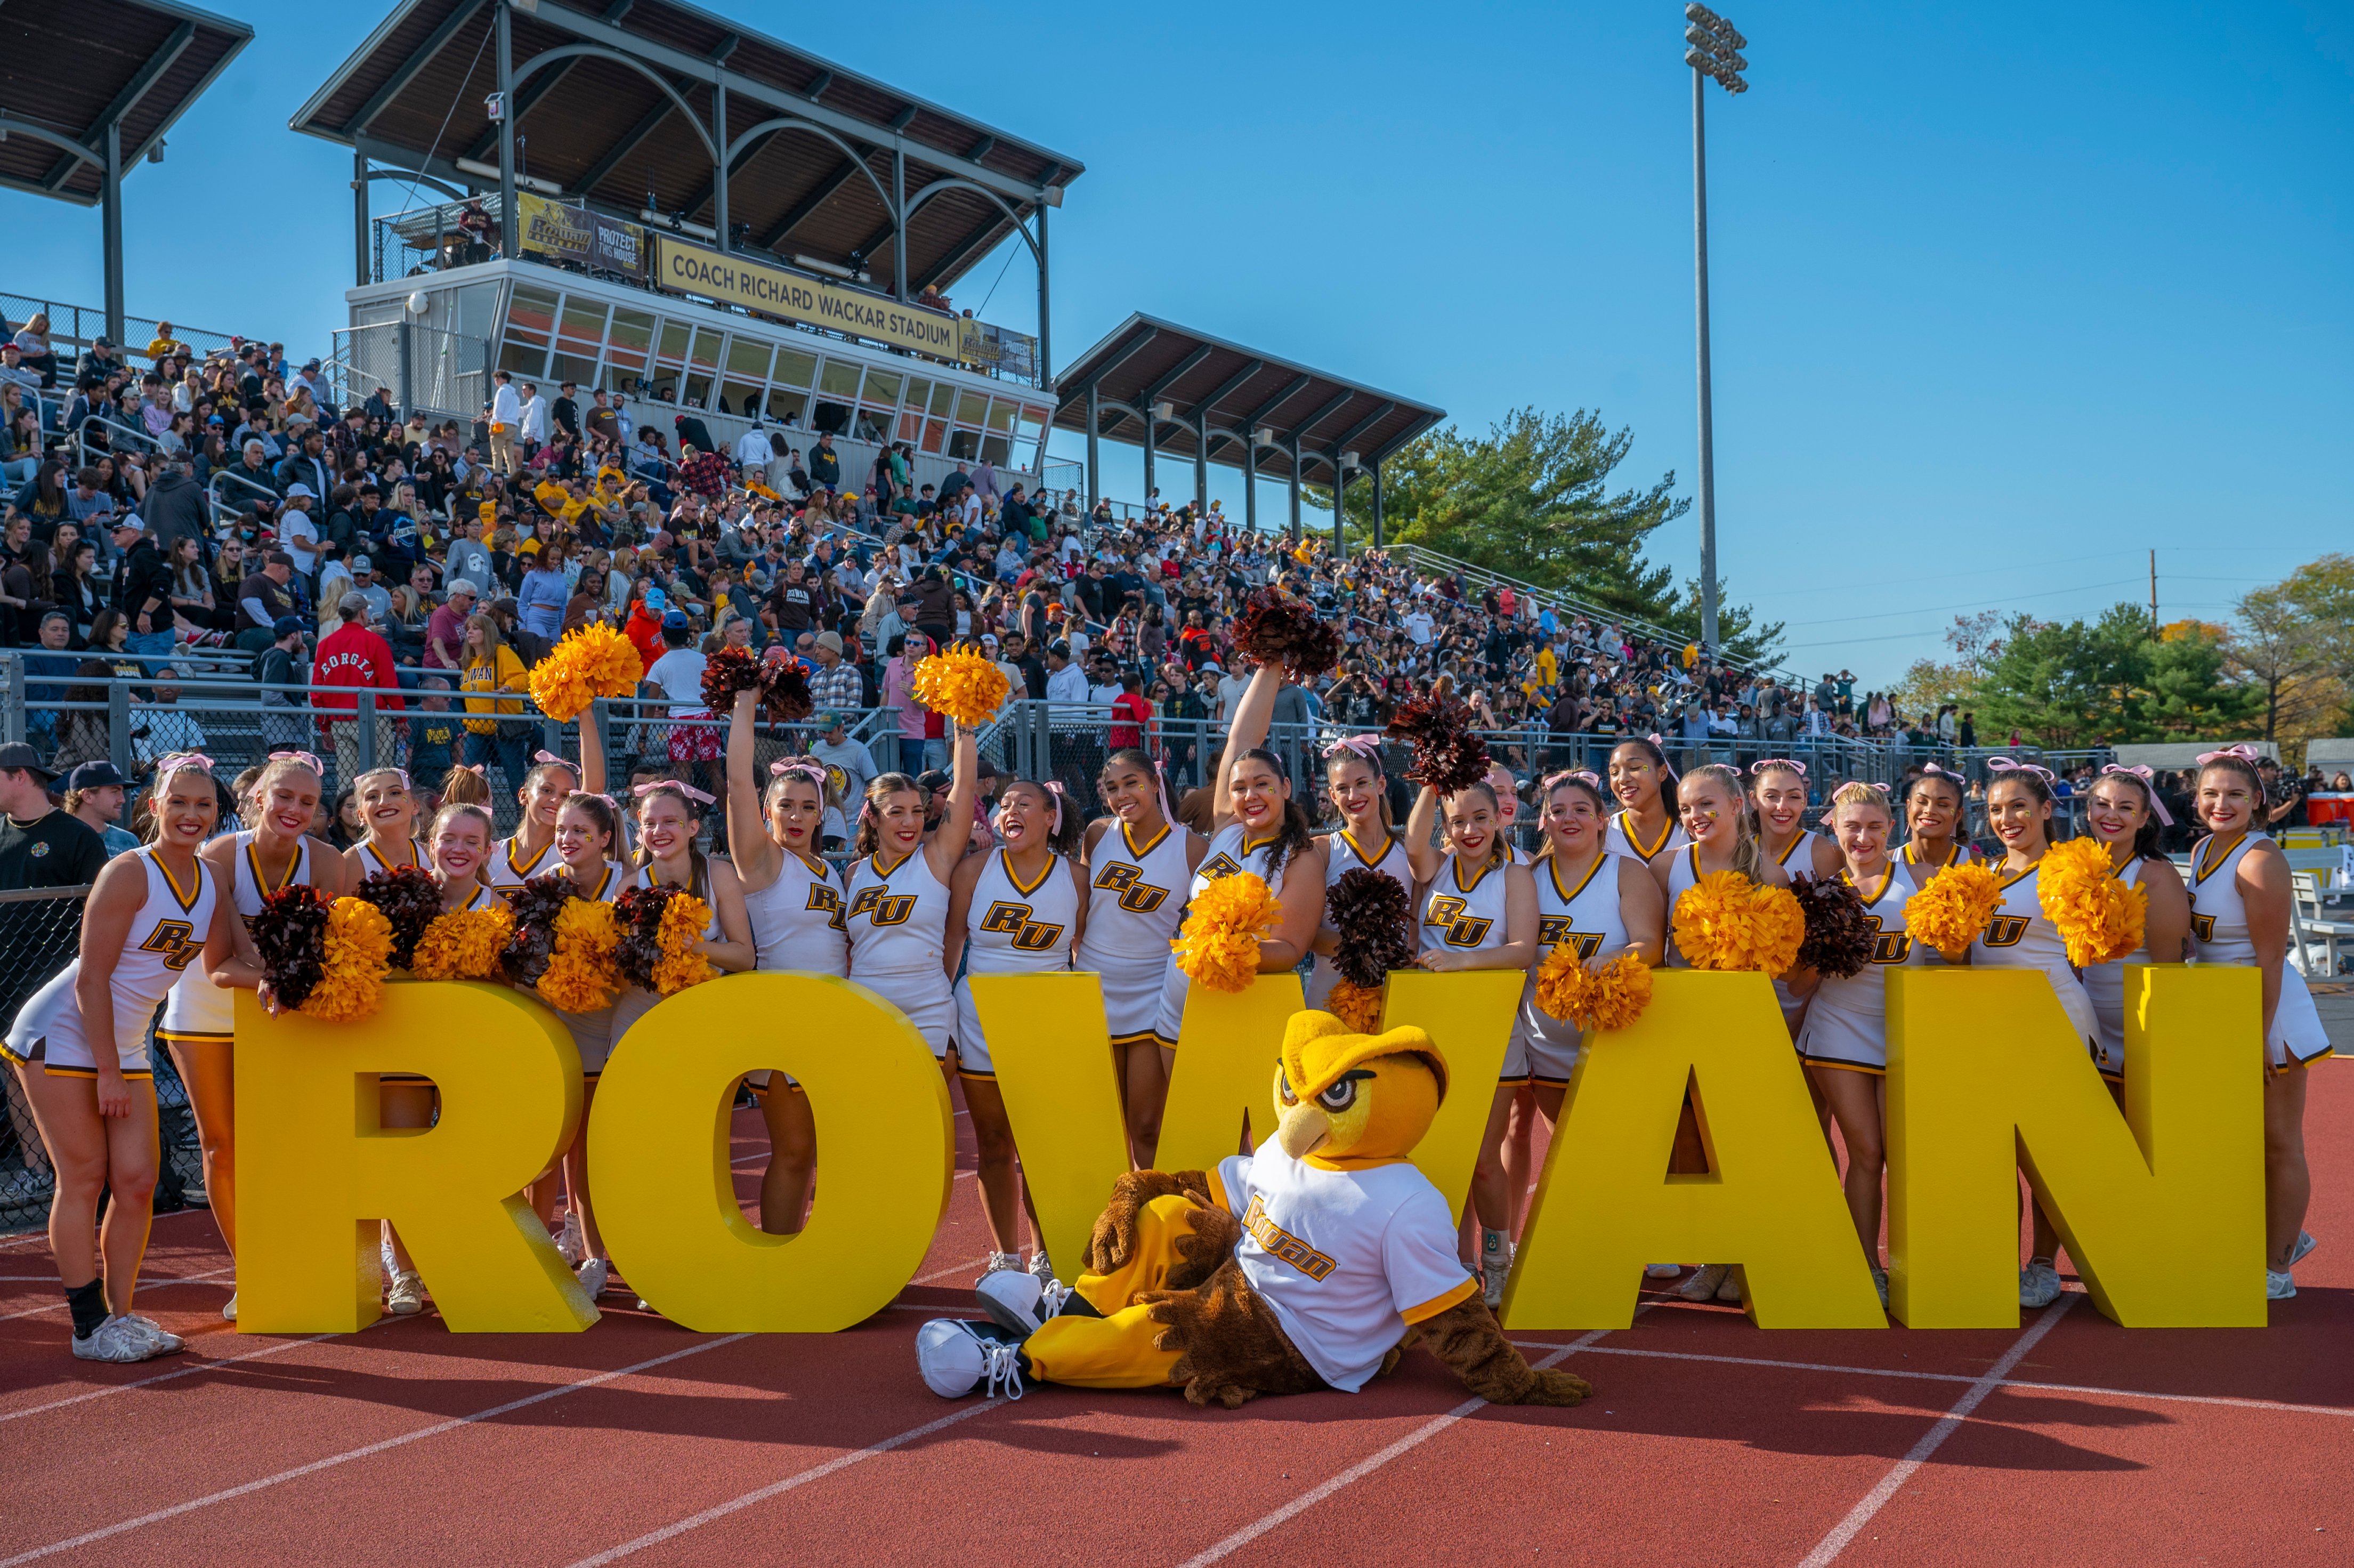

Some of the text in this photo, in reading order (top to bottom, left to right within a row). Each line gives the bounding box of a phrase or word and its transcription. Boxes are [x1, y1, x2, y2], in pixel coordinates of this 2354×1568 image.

[528, 231, 586, 252] FOOTBALL
[598, 226, 635, 252] PROTECT
[598, 241, 638, 265] THIS HOUSE.
[673, 254, 950, 347] COACH RICHARD WACKAR STADIUM
[1006, 340, 1031, 357] PROTECT
[787, 588, 809, 601] ROWAN
[321, 653, 374, 683] EORGIA
[1094, 860, 1170, 913] RU
[1196, 851, 1242, 882] R
[848, 884, 919, 926] RU
[980, 900, 1065, 951] RU
[1424, 895, 1494, 948] RU
[1979, 904, 2032, 947] U
[138, 918, 206, 971] RU
[234, 966, 2268, 1333] ROWAN
[1242, 1194, 1338, 1283] Rowan
